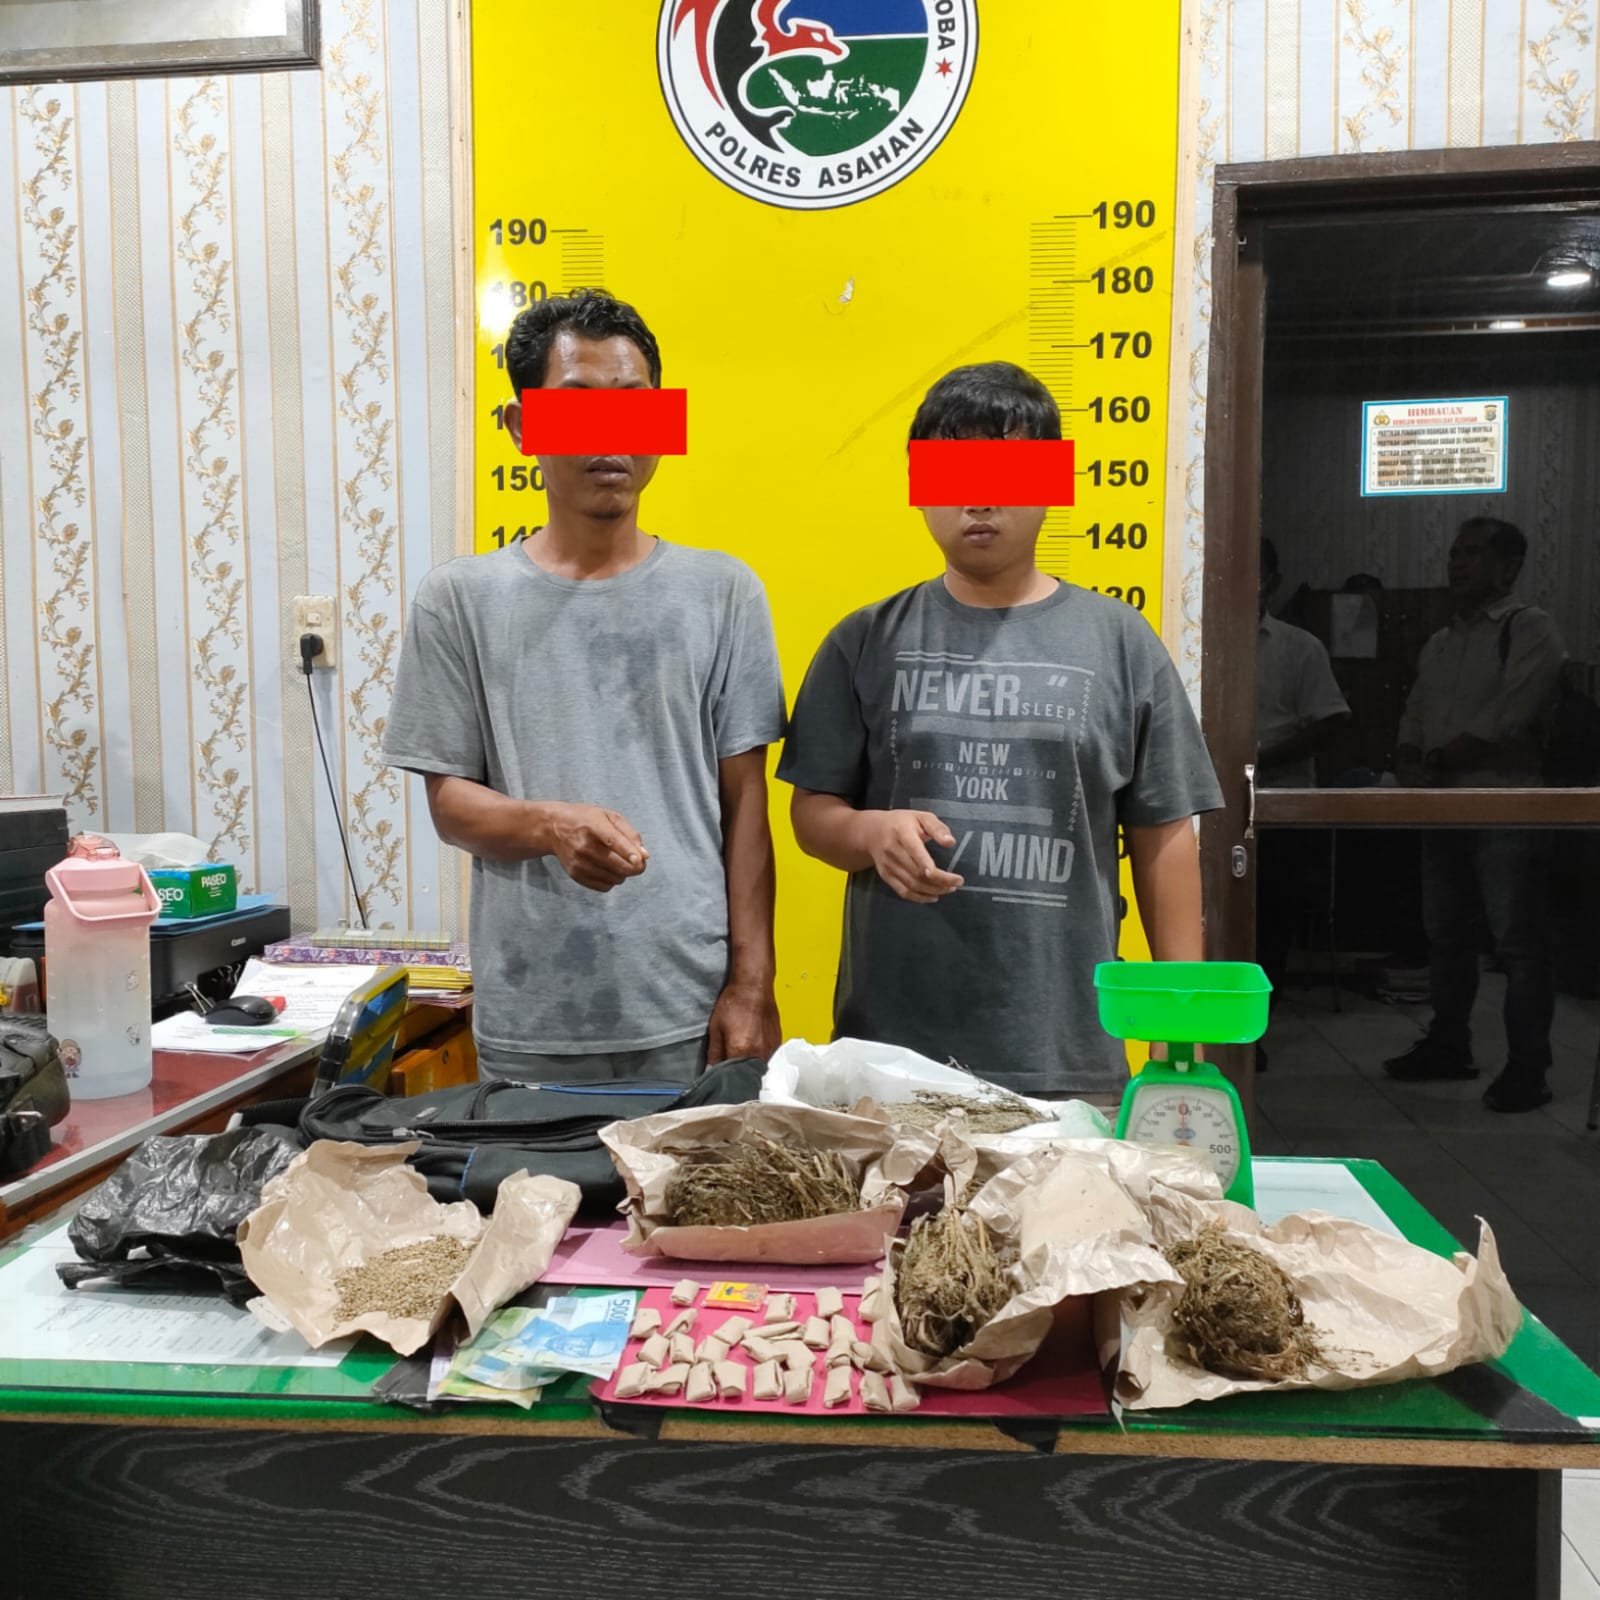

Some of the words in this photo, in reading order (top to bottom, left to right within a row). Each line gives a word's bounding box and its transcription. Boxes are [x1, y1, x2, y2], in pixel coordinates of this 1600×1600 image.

[935, 0, 956, 51] OBA
[704, 121, 801, 188] POLRES
[818, 118, 924, 189] ASAHAN
[1092, 199, 1156, 230] 190
[489, 218, 547, 246] 190
[1091, 265, 1154, 295] 180
[1089, 330, 1153, 360] 170
[1088, 395, 1151, 424] 160
[491, 465, 546, 491] 150
[1086, 458, 1150, 487] 150
[1085, 522, 1148, 550] 140
[890, 669, 1021, 717] NEVER
[1021, 702, 1076, 721] SLEEP
[958, 741, 1010, 766] NEW
[954, 775, 1009, 801] YORK
[978, 831, 1075, 884] MIND
[157, 887, 184, 902] SEO
[201, 873, 227, 889] PASEO
[1209, 1144, 1231, 1154] 500
